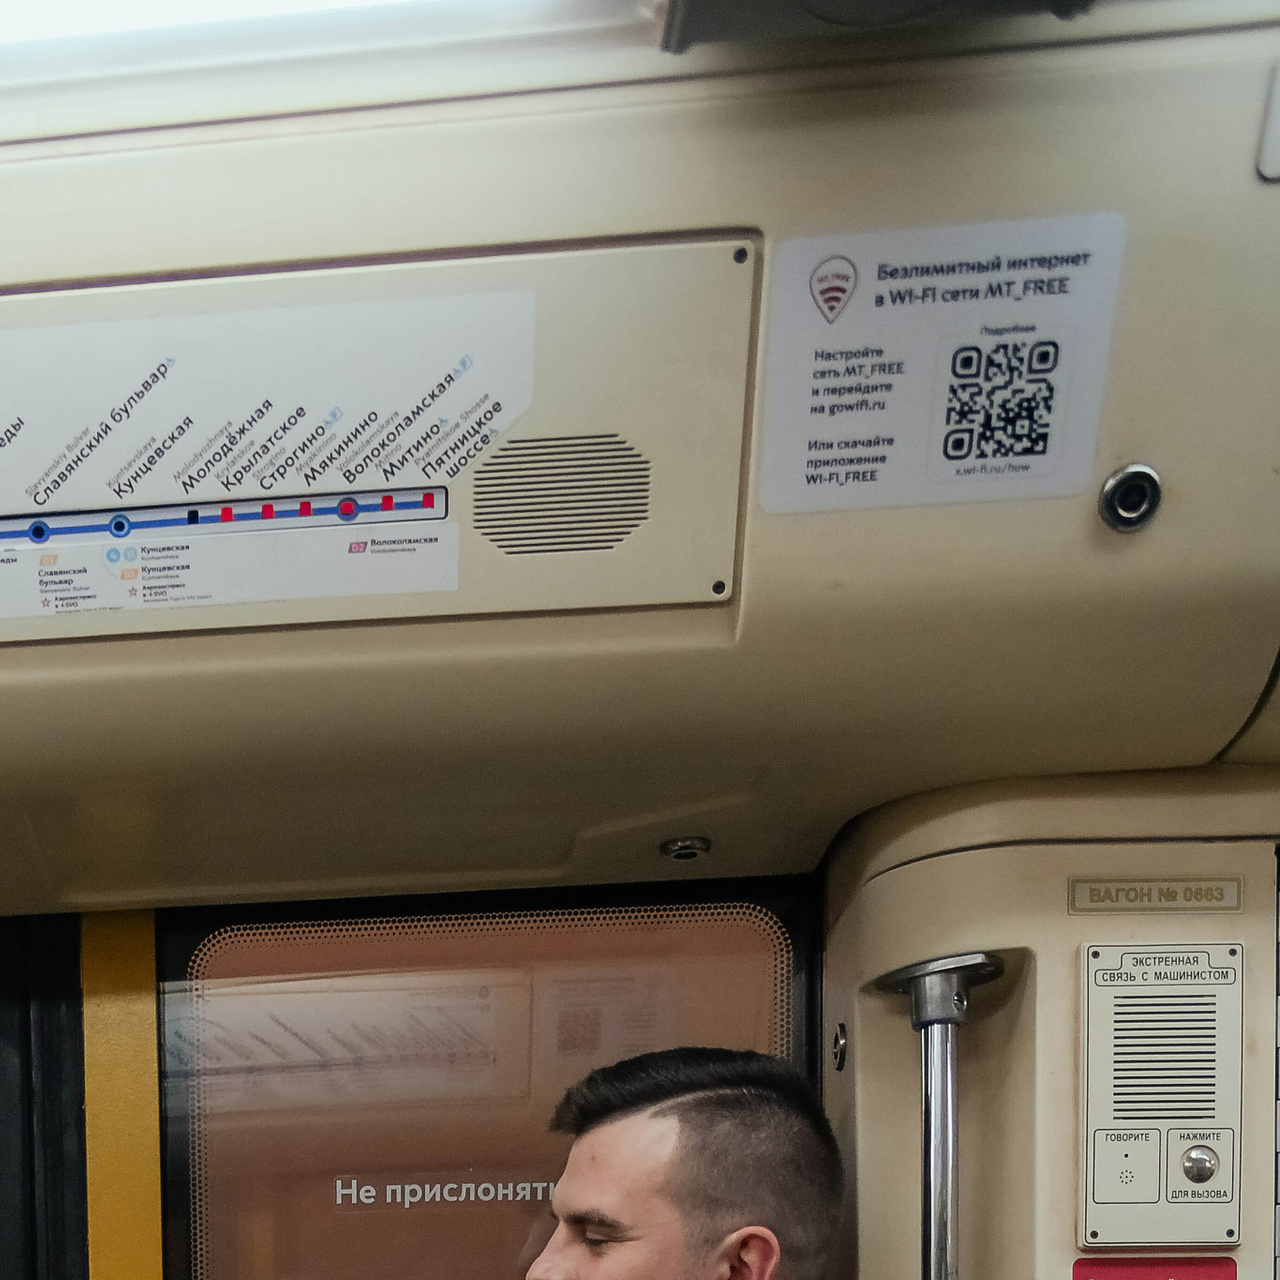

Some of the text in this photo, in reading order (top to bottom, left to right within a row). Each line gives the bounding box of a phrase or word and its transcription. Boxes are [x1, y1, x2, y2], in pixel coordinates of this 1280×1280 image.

[878, 253, 1091, 281] Безлимитный интернет
[875, 294, 884, 307] в
[941, 288, 979, 303] сети
[984, 277, 1070, 301] MT_FREE
[814, 347, 883, 362] Настройте
[812, 362, 904, 380] сеть MT_FREE
[812, 382, 892, 398] и перейдите
[810, 405, 825, 414] на
[33, 421, 112, 506] Славянский
[110, 363, 168, 423] бульвар
[342, 373, 455, 485] Волоколамская
[181, 399, 273, 495] Молодёжная
[421, 400, 503, 480] Пятницкое
[808, 436, 894, 451] Или скачайте
[112, 416, 194, 499] Кунцевская
[221, 406, 307, 492] Крылатское
[259, 425, 326, 490] Строгино
[303, 411, 378, 487] Мякинино
[382, 423, 440, 483] Митино
[445, 433, 491, 479] шоссе
[806, 455, 887, 470] приложение
[141, 544, 190, 554] Кунцевская
[370, 537, 438, 547] Волоколамская
[38, 567, 88, 577] Славянский
[141, 564, 190, 573] Кунцевская
[1089, 886, 1224, 903] ВАГОН № 0663
[1132, 956, 1199, 967] ЭКСТРЕННАЯ
[1102, 970, 1229, 982] СВЯЗЬ С МАШИНИСТОМ
[1105, 1133, 1150, 1142] ГОВОРИТЕ
[1179, 1132, 1221, 1140] НАЖМИТЕ
[335, 1179, 376, 1205] Не
[1171, 1190, 1228, 1199] ДЛЯ ВЫЗОВА
